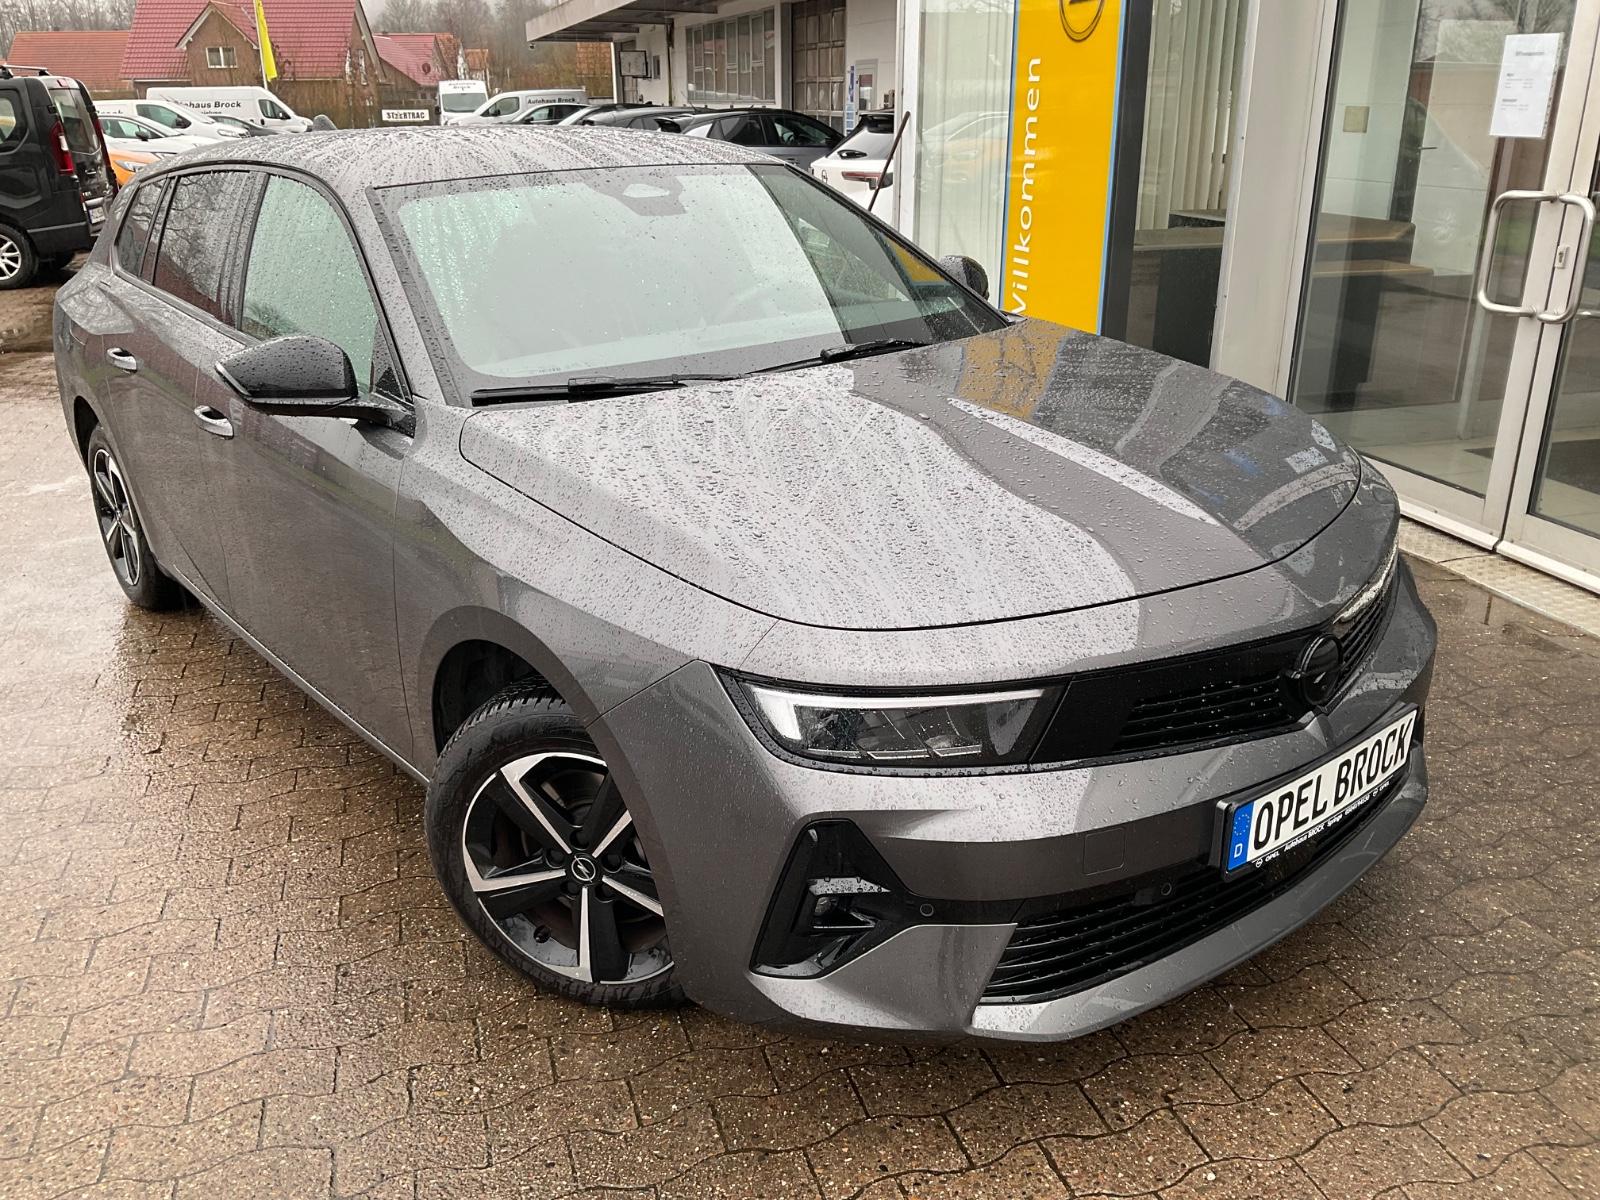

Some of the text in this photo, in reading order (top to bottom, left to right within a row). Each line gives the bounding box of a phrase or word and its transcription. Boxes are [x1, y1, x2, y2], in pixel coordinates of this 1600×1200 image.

[214, 100, 241, 108] Brock
[1253, 717, 1413, 851] OPEL BROCK
[1233, 843, 1243, 858] D
